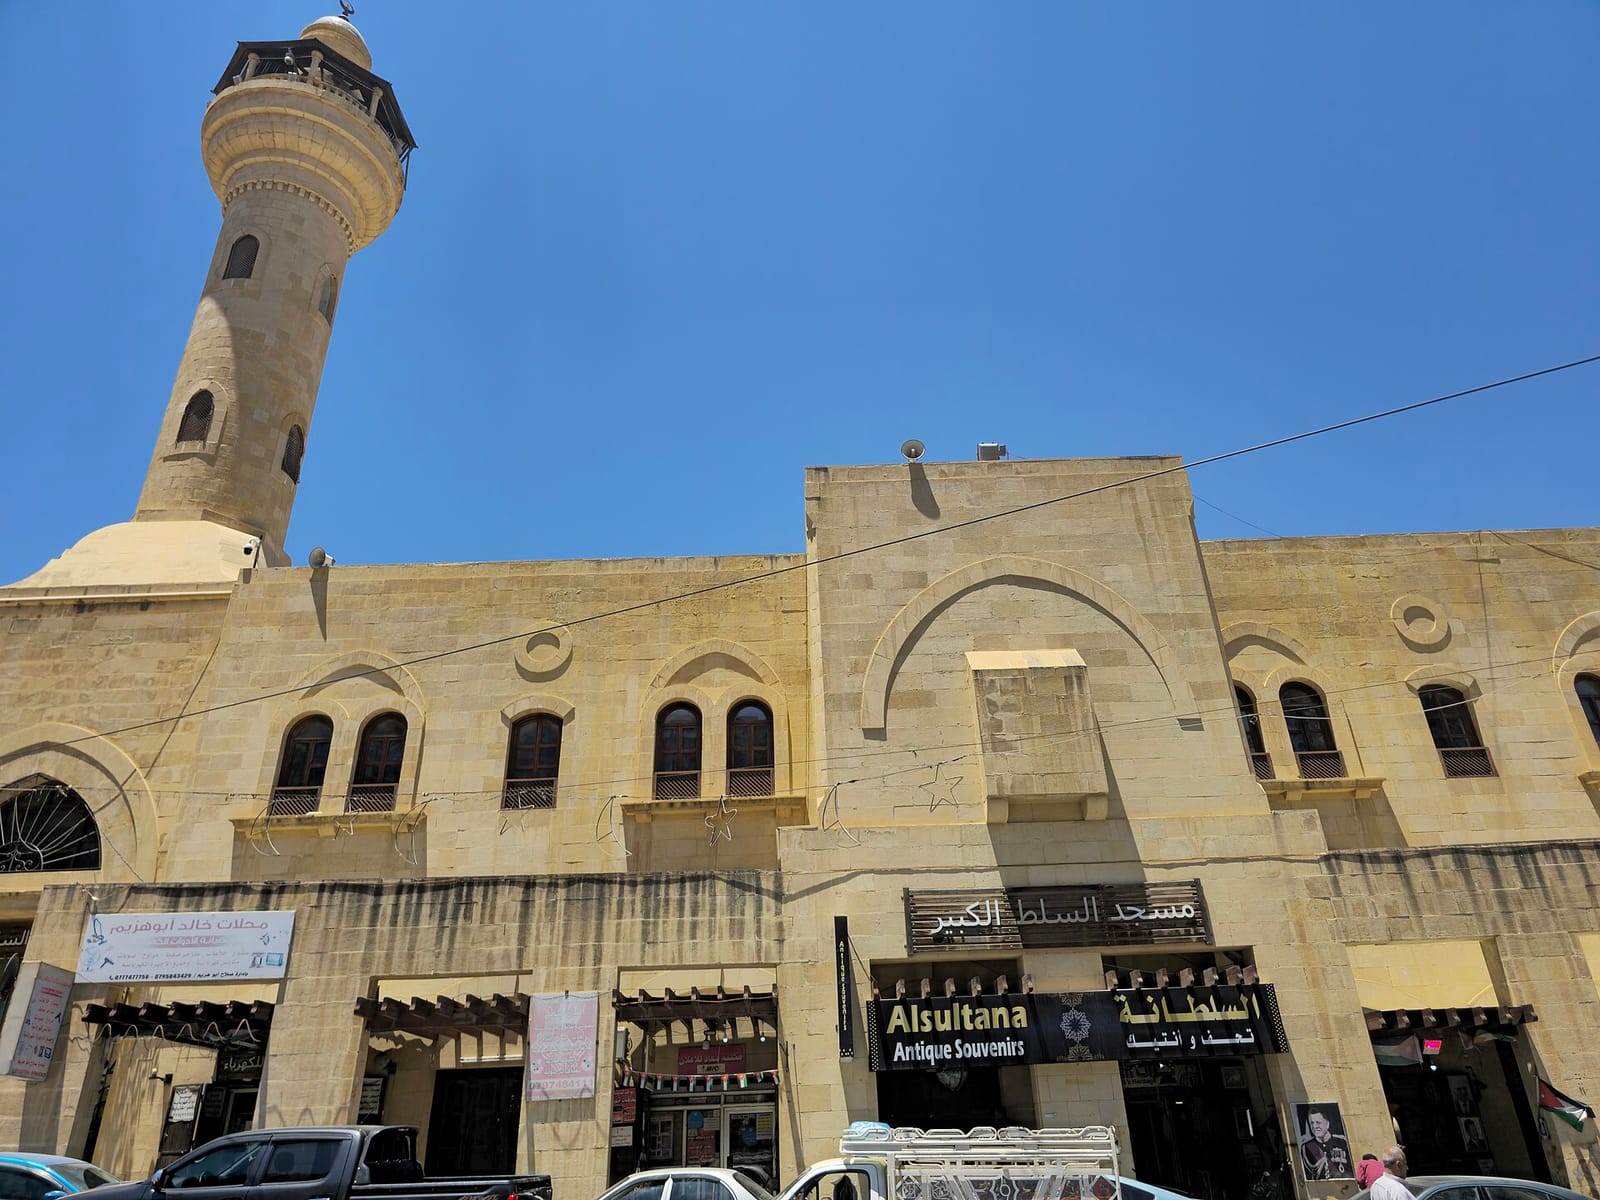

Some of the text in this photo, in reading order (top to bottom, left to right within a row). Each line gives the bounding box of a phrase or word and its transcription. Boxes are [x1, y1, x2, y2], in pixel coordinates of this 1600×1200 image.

[178, 918, 212, 931] خالد
[217, 917, 269, 931] محلات
[930, 896, 1196, 935] مسجد السلط الكبير
[886, 1002, 1028, 1034] Alsultana
[1114, 993, 1260, 1024] السلطانة
[1189, 1034, 1197, 1050] و
[1201, 1028, 1255, 1045] تحف
[893, 1036, 1025, 1066] Antique Souvenirs
